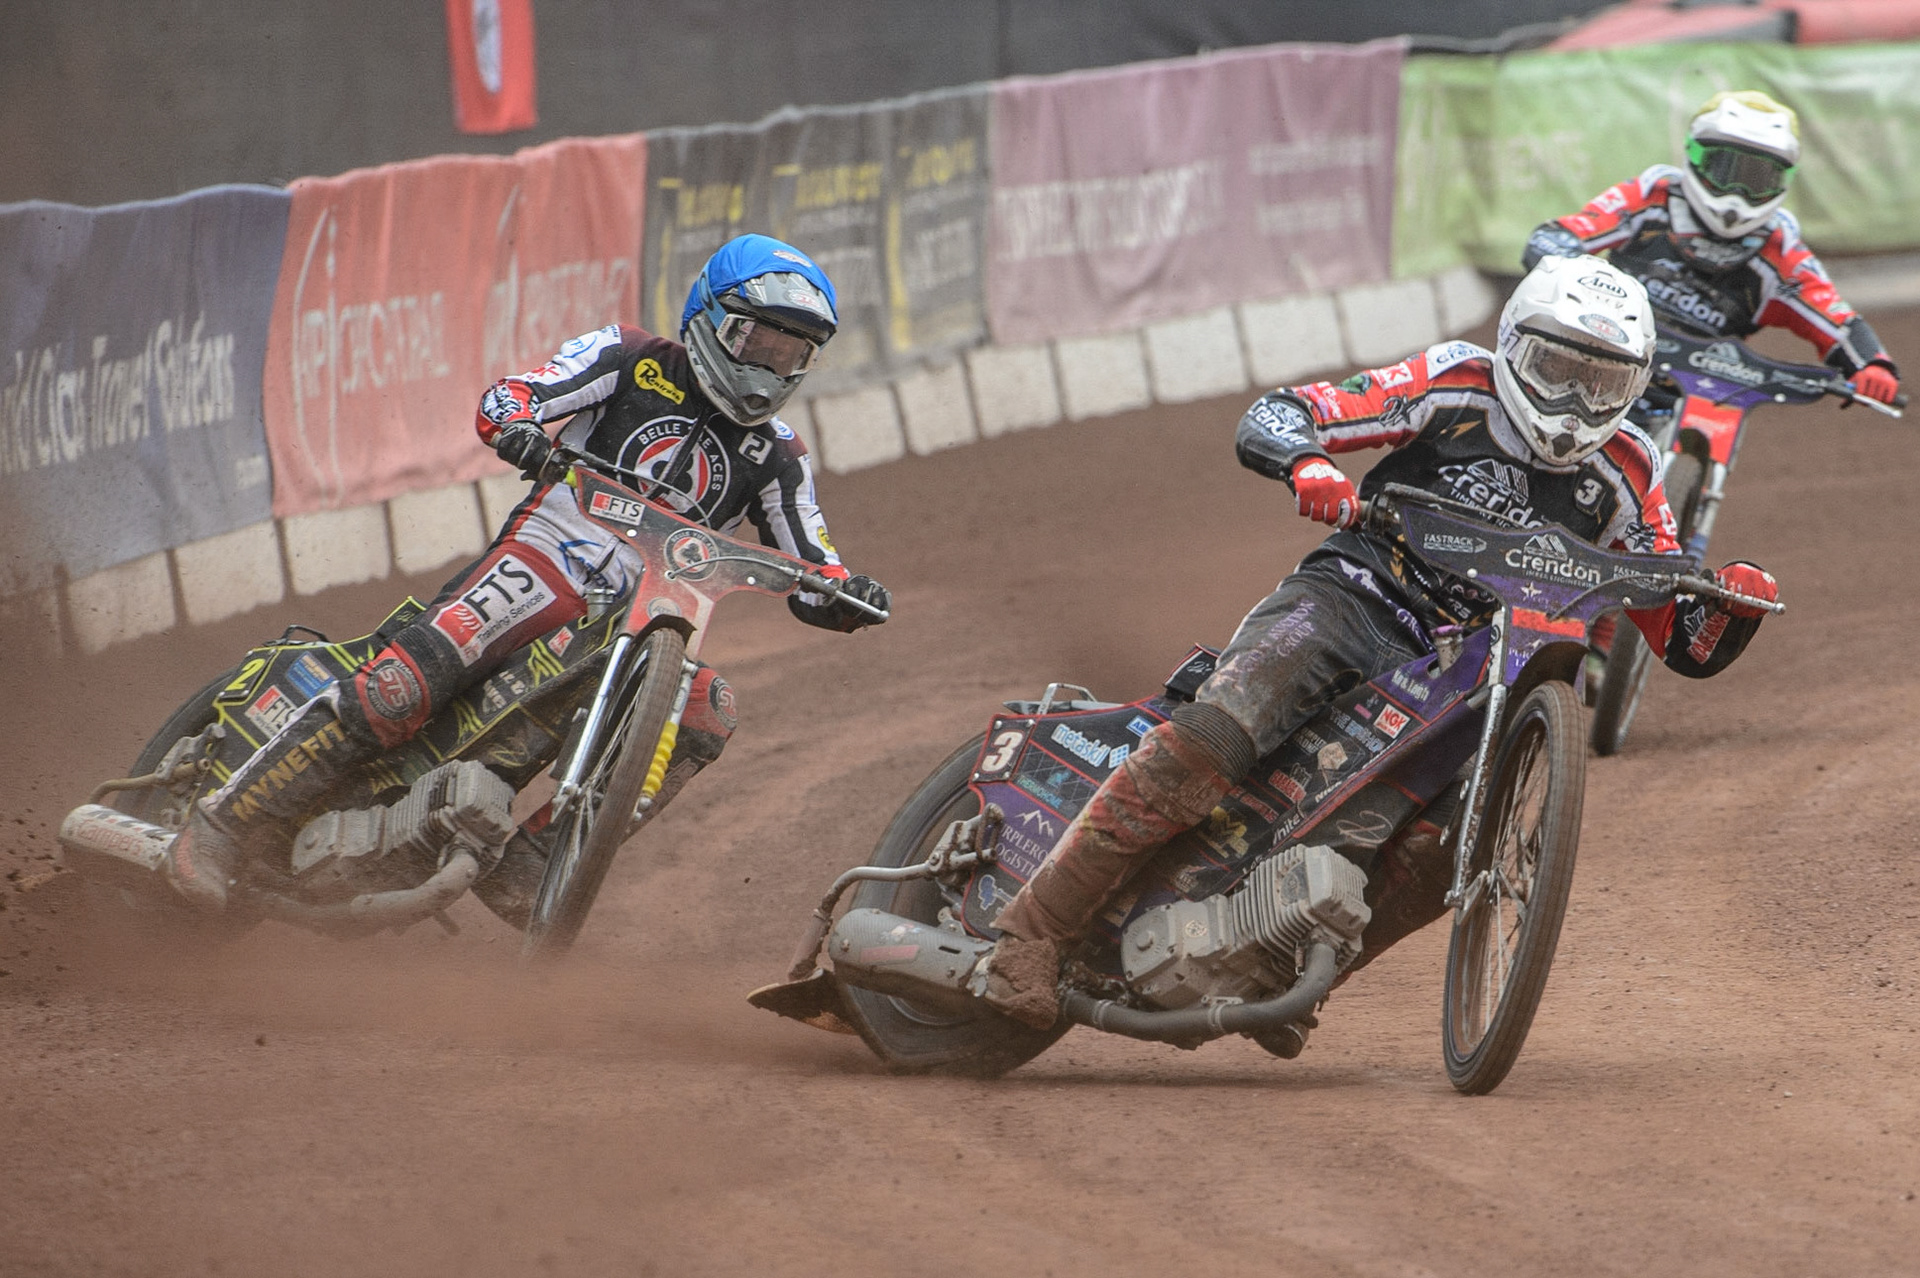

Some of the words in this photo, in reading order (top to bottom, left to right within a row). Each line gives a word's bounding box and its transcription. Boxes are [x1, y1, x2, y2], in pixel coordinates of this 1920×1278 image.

[1591, 276, 1623, 295] Arai
[1688, 350, 1765, 386] Crendon
[638, 423, 681, 445] BELLE
[709, 454, 724, 492] ACES
[745, 434, 767, 463] 2
[608, 496, 642, 518] FTS
[1437, 464, 1546, 530] Crendo
[1575, 478, 1604, 506] 3
[1424, 533, 1474, 547] FASTRACK
[1505, 548, 1601, 584] Crendon
[463, 560, 535, 624] FTS
[477, 617, 511, 644] Training
[510, 591, 545, 619] Services
[224, 658, 266, 692] 2
[1382, 708, 1406, 733] NGK
[981, 731, 1023, 772] 3
[1051, 724, 1111, 768] metaskil
[232, 719, 345, 821] MYNEFIT
[995, 842, 1038, 877] OGISTI
[1001, 823, 1048, 862] RPLERO
